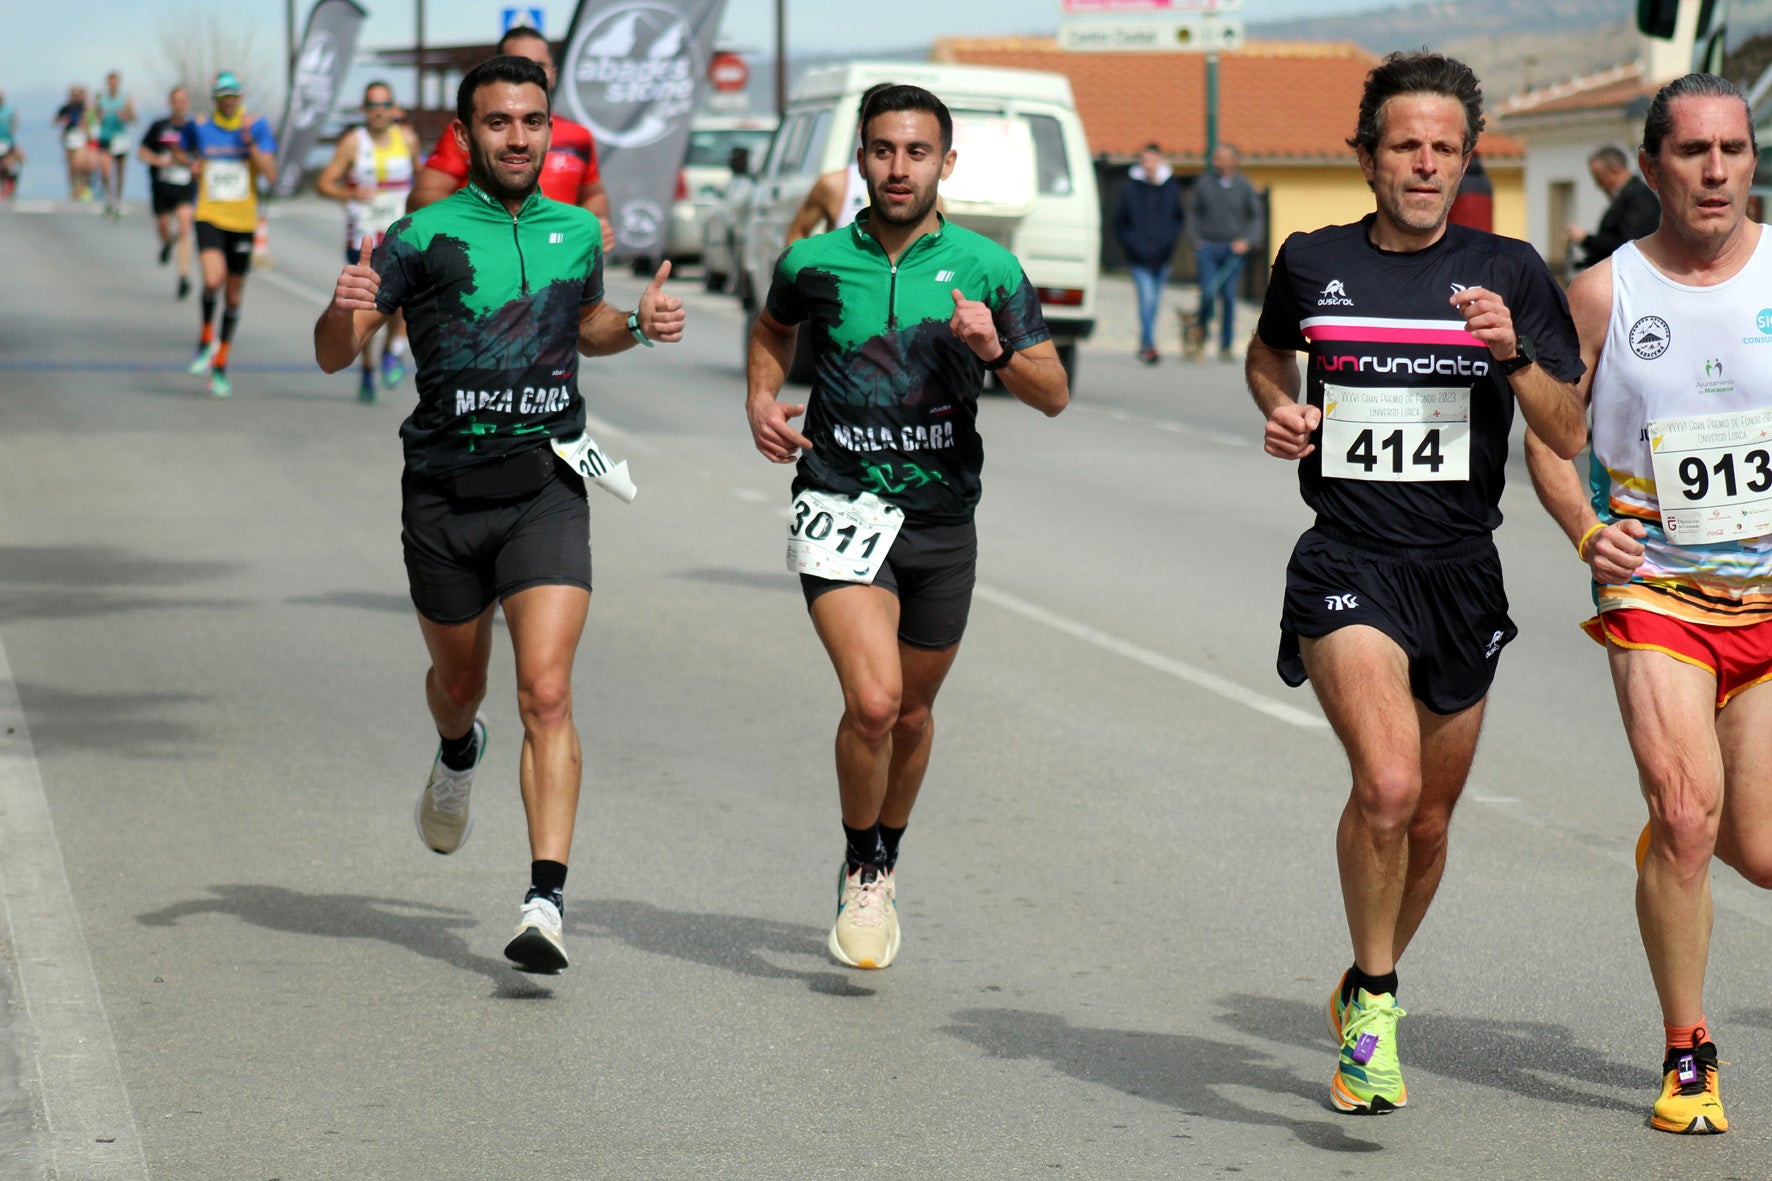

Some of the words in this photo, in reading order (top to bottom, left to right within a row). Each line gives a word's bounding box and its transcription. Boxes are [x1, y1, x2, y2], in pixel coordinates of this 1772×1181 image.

[519, 385, 570, 414] CARA
[1361, 392, 1378, 403] GRAN
[1380, 393, 1403, 403] PREMIO
[1416, 393, 1436, 403] FONDO
[1438, 392, 1457, 403] 2023
[1704, 386, 1734, 394] Maracena
[1369, 407, 1399, 417] UNIVERSO
[1401, 408, 1420, 417] LORCA
[1688, 420, 1705, 431] GRAN
[1707, 418, 1729, 430] PREMIO
[834, 423, 898, 452] MALA
[901, 421, 955, 452] CARA
[1697, 432, 1727, 444] UNIVERSO
[1728, 430, 1748, 442] LORCA
[1346, 429, 1444, 473] 414
[1679, 449, 1772, 501] 913
[790, 500, 882, 559] 3011
